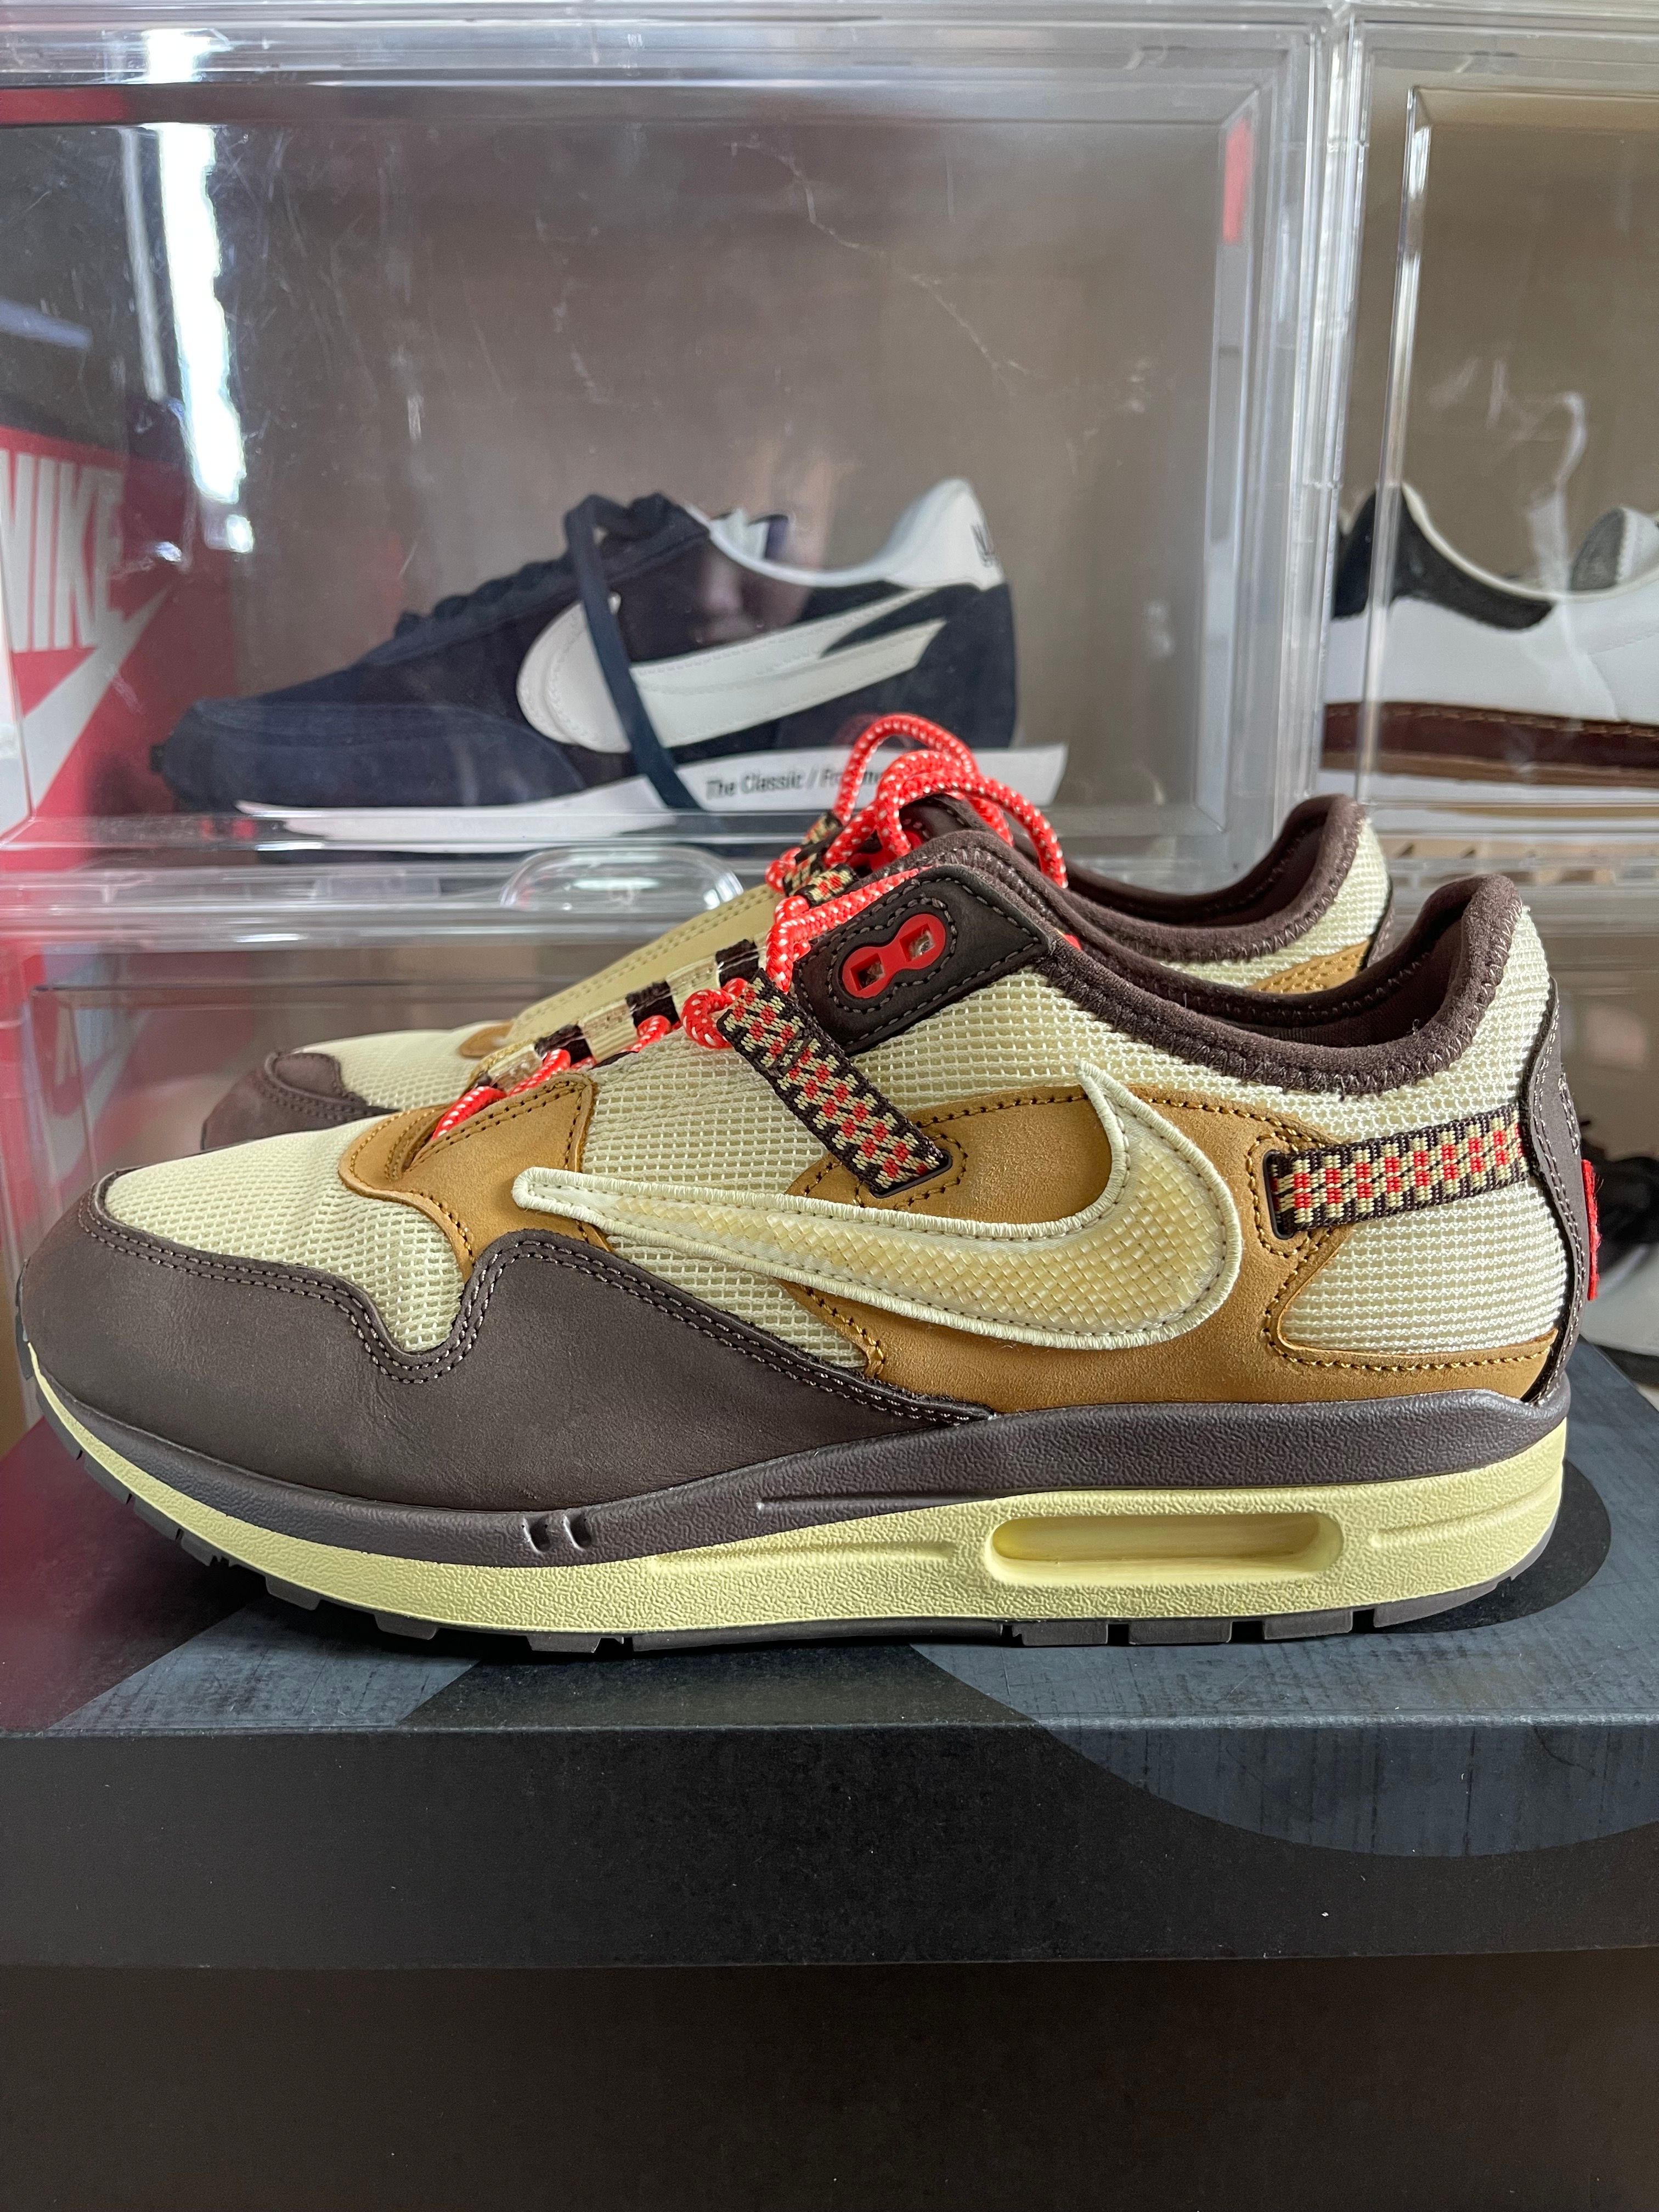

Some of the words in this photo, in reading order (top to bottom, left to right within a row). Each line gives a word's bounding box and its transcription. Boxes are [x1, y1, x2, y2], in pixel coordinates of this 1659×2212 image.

[0, 449, 126, 653] NIKE
[706, 778, 735, 800] The
[741, 768, 802, 794] Classic
